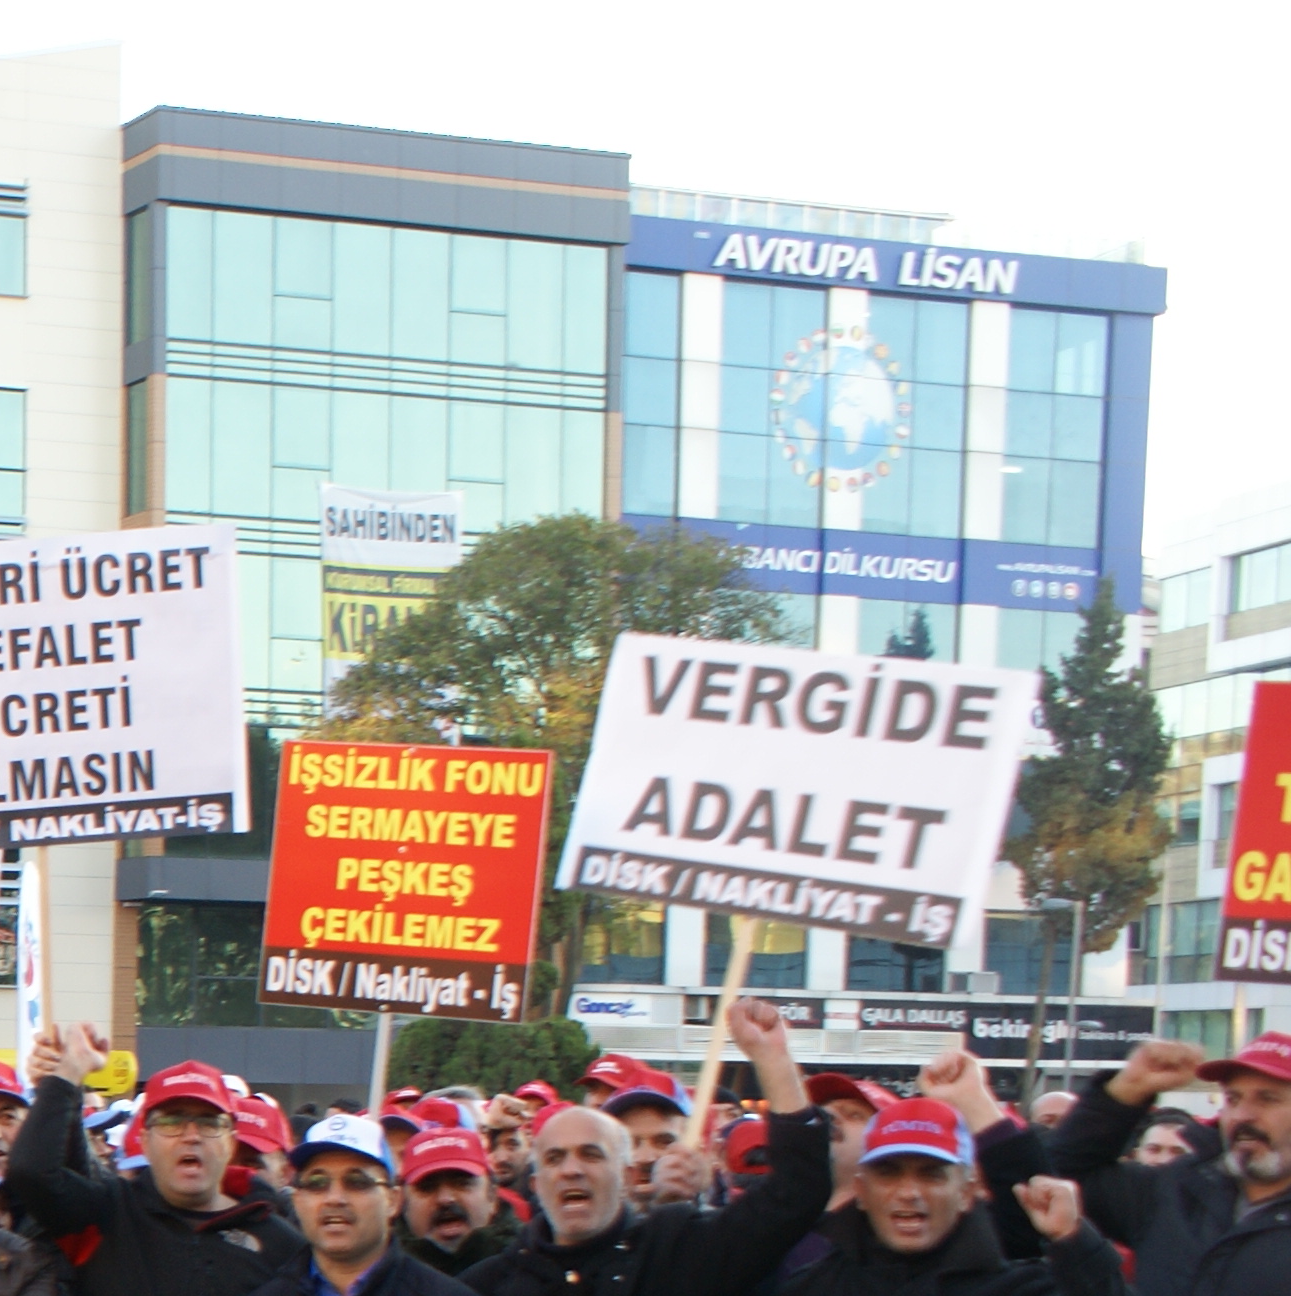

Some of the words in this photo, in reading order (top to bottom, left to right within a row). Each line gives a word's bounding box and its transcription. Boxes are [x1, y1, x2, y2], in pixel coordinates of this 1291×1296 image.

[712, 233, 878, 282] AVRUPA
[898, 248, 1019, 295] LİSAN
[325, 503, 456, 543] SAHİBİNDEN
[59, 546, 210, 600] ÜCRET
[731, 545, 819, 573] BANCI
[824, 547, 860, 576] DİL
[860, 555, 958, 583] KURSU
[642, 655, 998, 750] VERGİDE
[289, 745, 437, 794] İŞSİZLİK
[444, 760, 545, 797] FONU
[9, 800, 225, 842] NAKLİYAT-İŞ
[305, 804, 517, 848] SERMAYEYE
[621, 776, 947, 870] ADALET
[335, 857, 474, 907] PEŞKEŞ
[579, 852, 672, 896] DİSK
[692, 869, 885, 925] NAKLİYAT
[908, 895, 955, 943] İŞ
[1232, 850, 1291, 901] GA
[300, 903, 502, 953] ÇEKİLEMEZ
[1222, 919, 1291, 972] DİS
[265, 949, 337, 996] DİSK
[337, 962, 353, 997] /
[354, 962, 472, 1013] Nakliyat
[490, 964, 520, 1019] İş
[778, 1002, 810, 1021] FÖR
